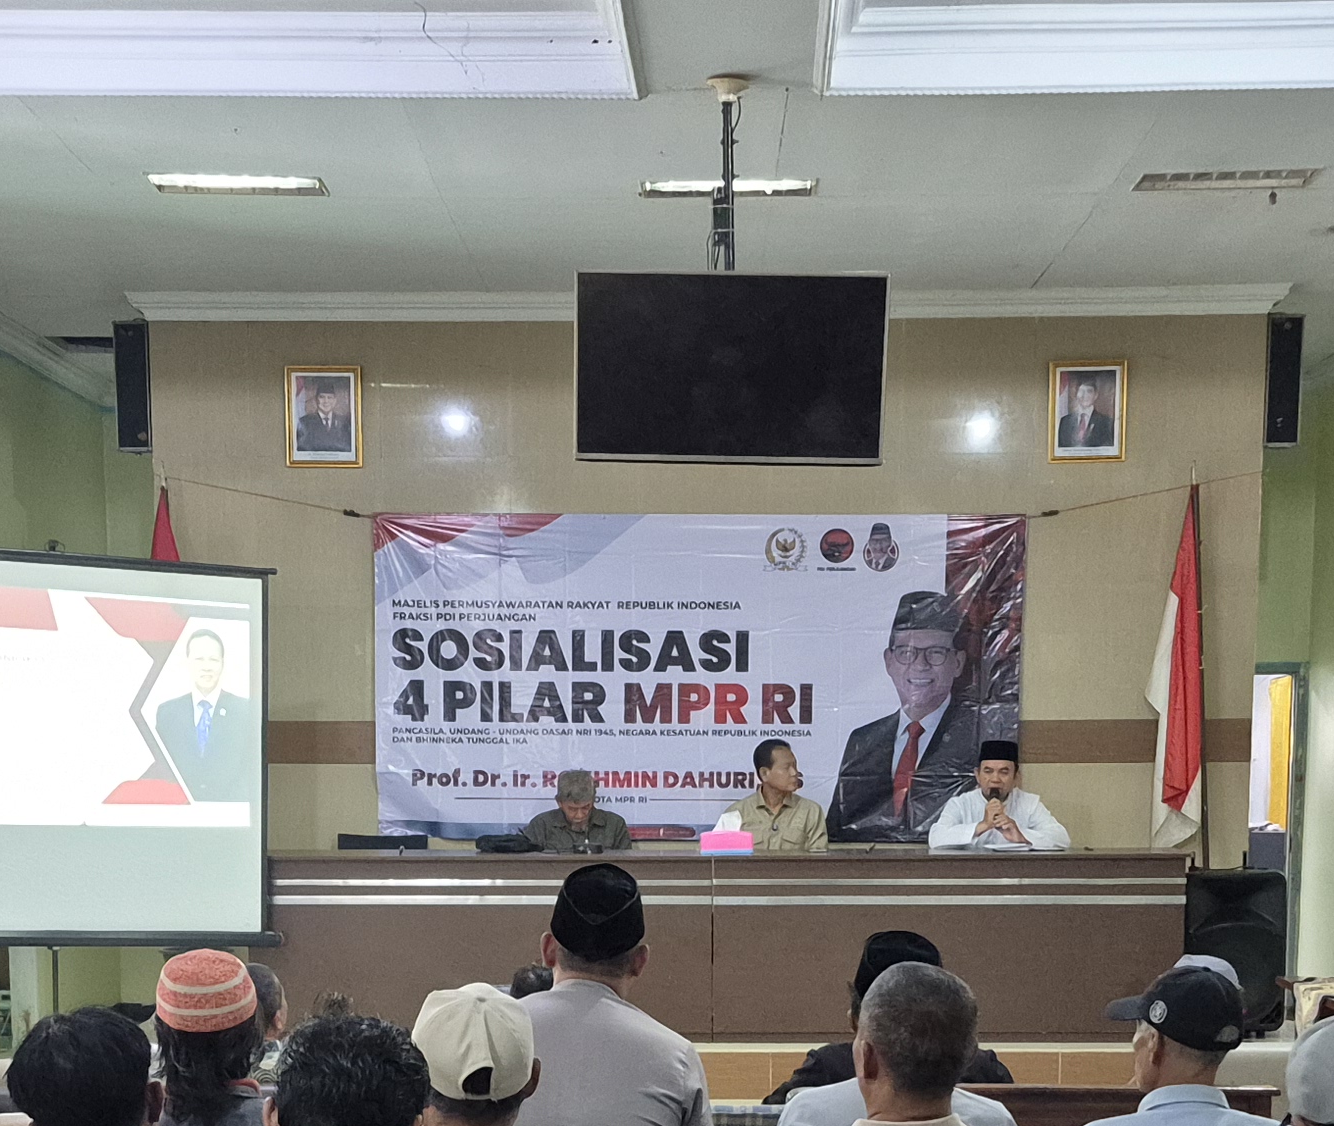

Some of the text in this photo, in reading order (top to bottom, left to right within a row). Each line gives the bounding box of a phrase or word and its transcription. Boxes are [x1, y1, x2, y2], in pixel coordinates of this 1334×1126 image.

[392, 599, 742, 611] MAJELIS PERMUSYAWARATAN RAKYAT REPUBLIK INDONESIA
[392, 612, 537, 622] FRAKSI PDI PERJUANGAN
[392, 628, 749, 673] SOSIALISASI
[393, 679, 814, 725] 4 PILAR MPR RI
[392, 727, 446, 736] PANCASILA,
[449, 727, 490, 736] UNDANG
[498, 728, 539, 736] UNDANG
[541, 728, 573, 736] DASAR
[575, 728, 591, 736] NRI
[593, 728, 616, 737] 1945,
[619, 729, 657, 737] NEGARA
[660, 729, 709, 737] KESATUAN
[711, 729, 757, 737] REPUBLIK
[760, 729, 812, 738] INDONESIA
[392, 736, 528, 745] DAN BHINNEKA TUNGGAL IKA
[411, 768, 468, 788] Prof.
[472, 770, 507, 787] Dr.
[542, 770, 658, 789] RHMIN
[615, 796, 636, 804] MPR
[639, 796, 647, 804] RI
